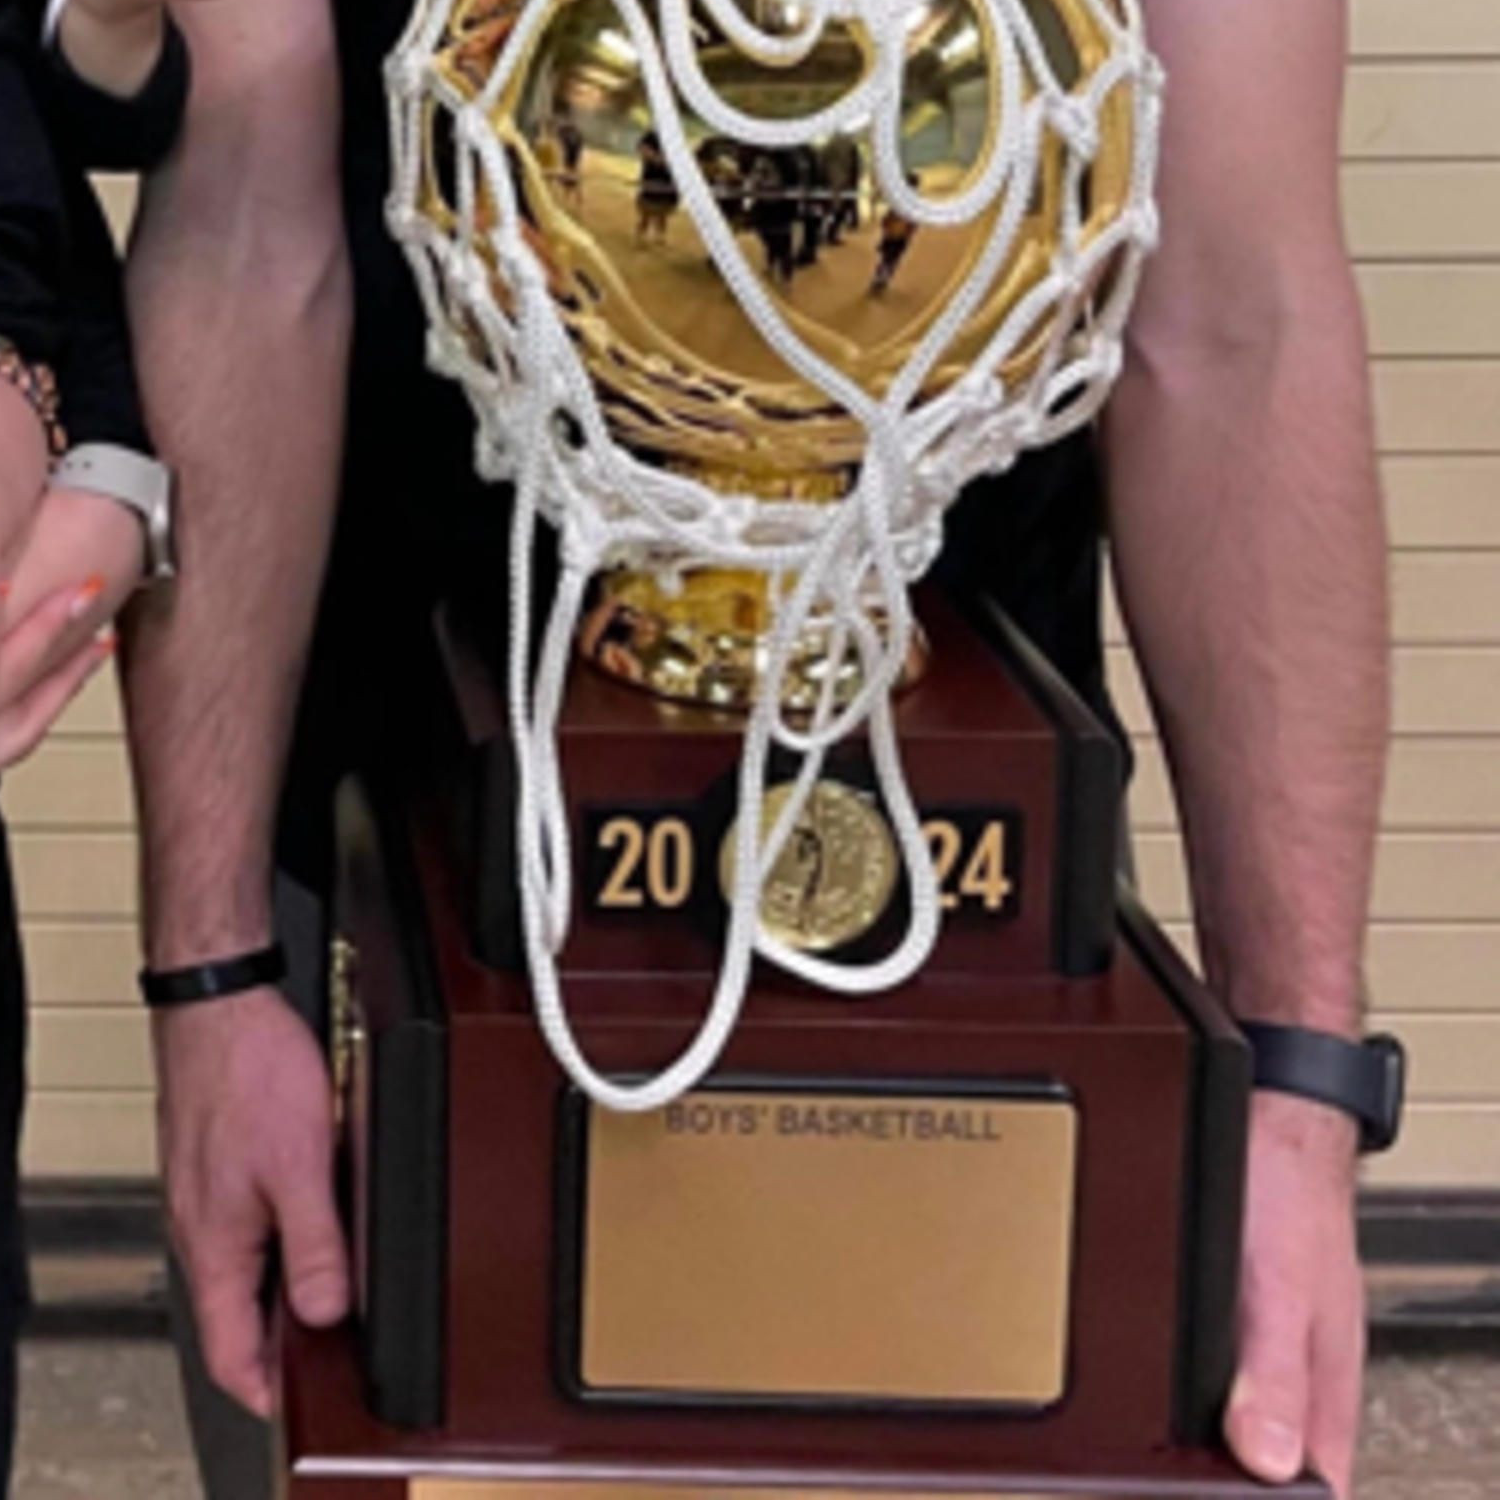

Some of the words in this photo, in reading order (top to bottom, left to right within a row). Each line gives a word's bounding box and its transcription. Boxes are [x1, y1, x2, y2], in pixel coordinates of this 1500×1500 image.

[598, 817, 694, 908] 20
[920, 818, 1012, 909] 24
[664, 1101, 769, 1135] BOYS'
[777, 1103, 1002, 1142] BASKETBALL
